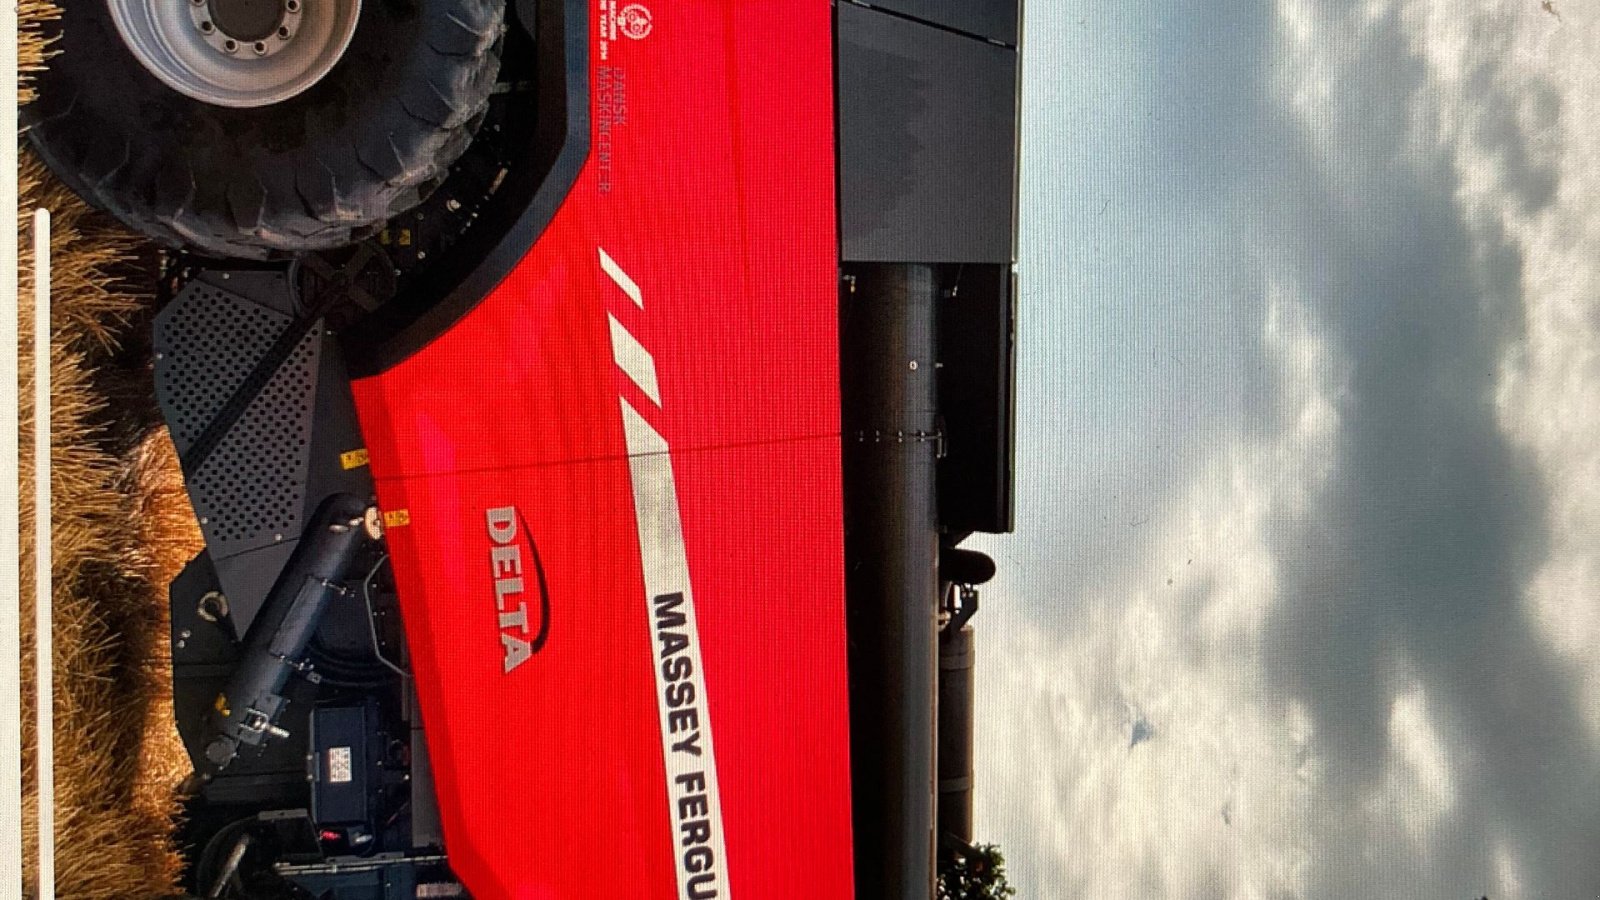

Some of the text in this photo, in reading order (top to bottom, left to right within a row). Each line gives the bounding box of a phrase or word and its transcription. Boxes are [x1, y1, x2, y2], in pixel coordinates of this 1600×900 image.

[599, 14, 607, 38] YEAR
[613, 67, 626, 124] DANSK
[486, 506, 533, 673] DELTA
[653, 591, 717, 900] MASSEY FERGU
